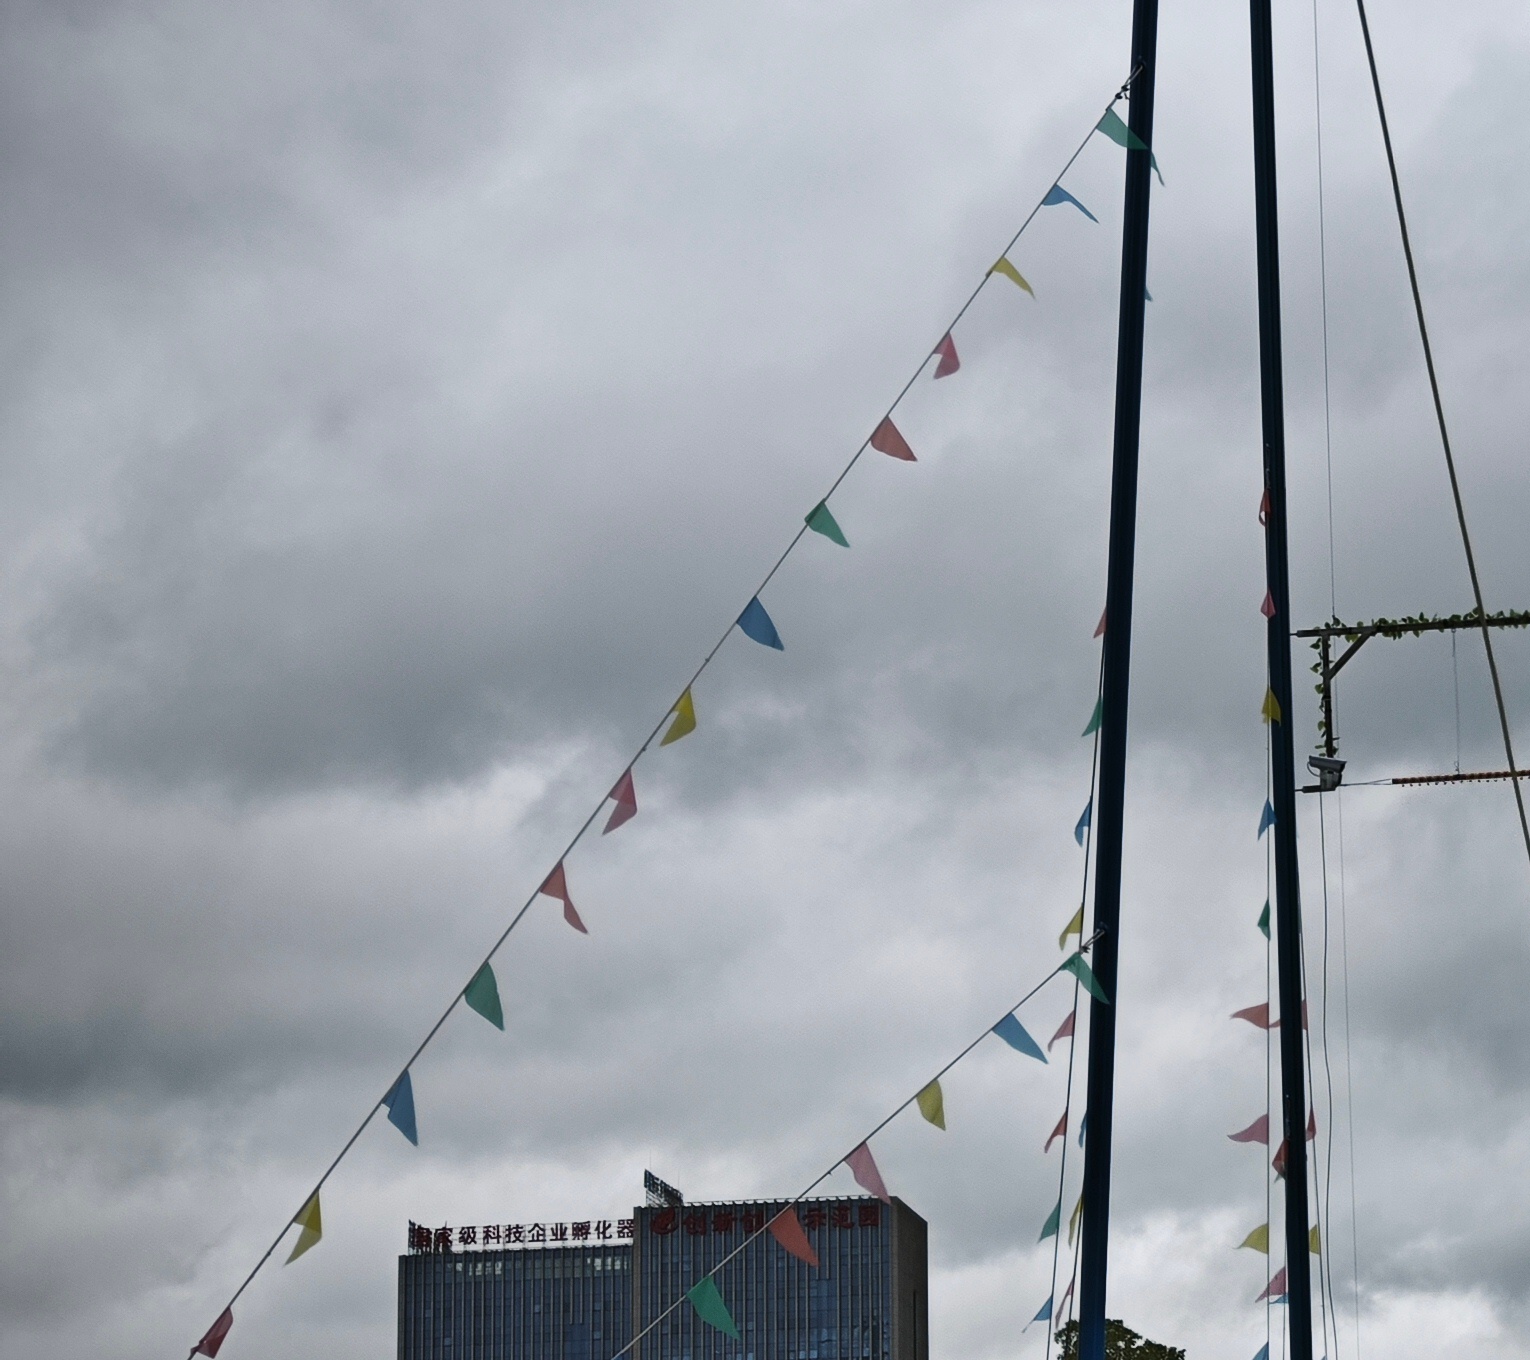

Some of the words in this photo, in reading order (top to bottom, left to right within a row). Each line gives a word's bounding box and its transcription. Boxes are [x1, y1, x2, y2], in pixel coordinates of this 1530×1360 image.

[682, 1203, 880, 1236] 创新创示范园
